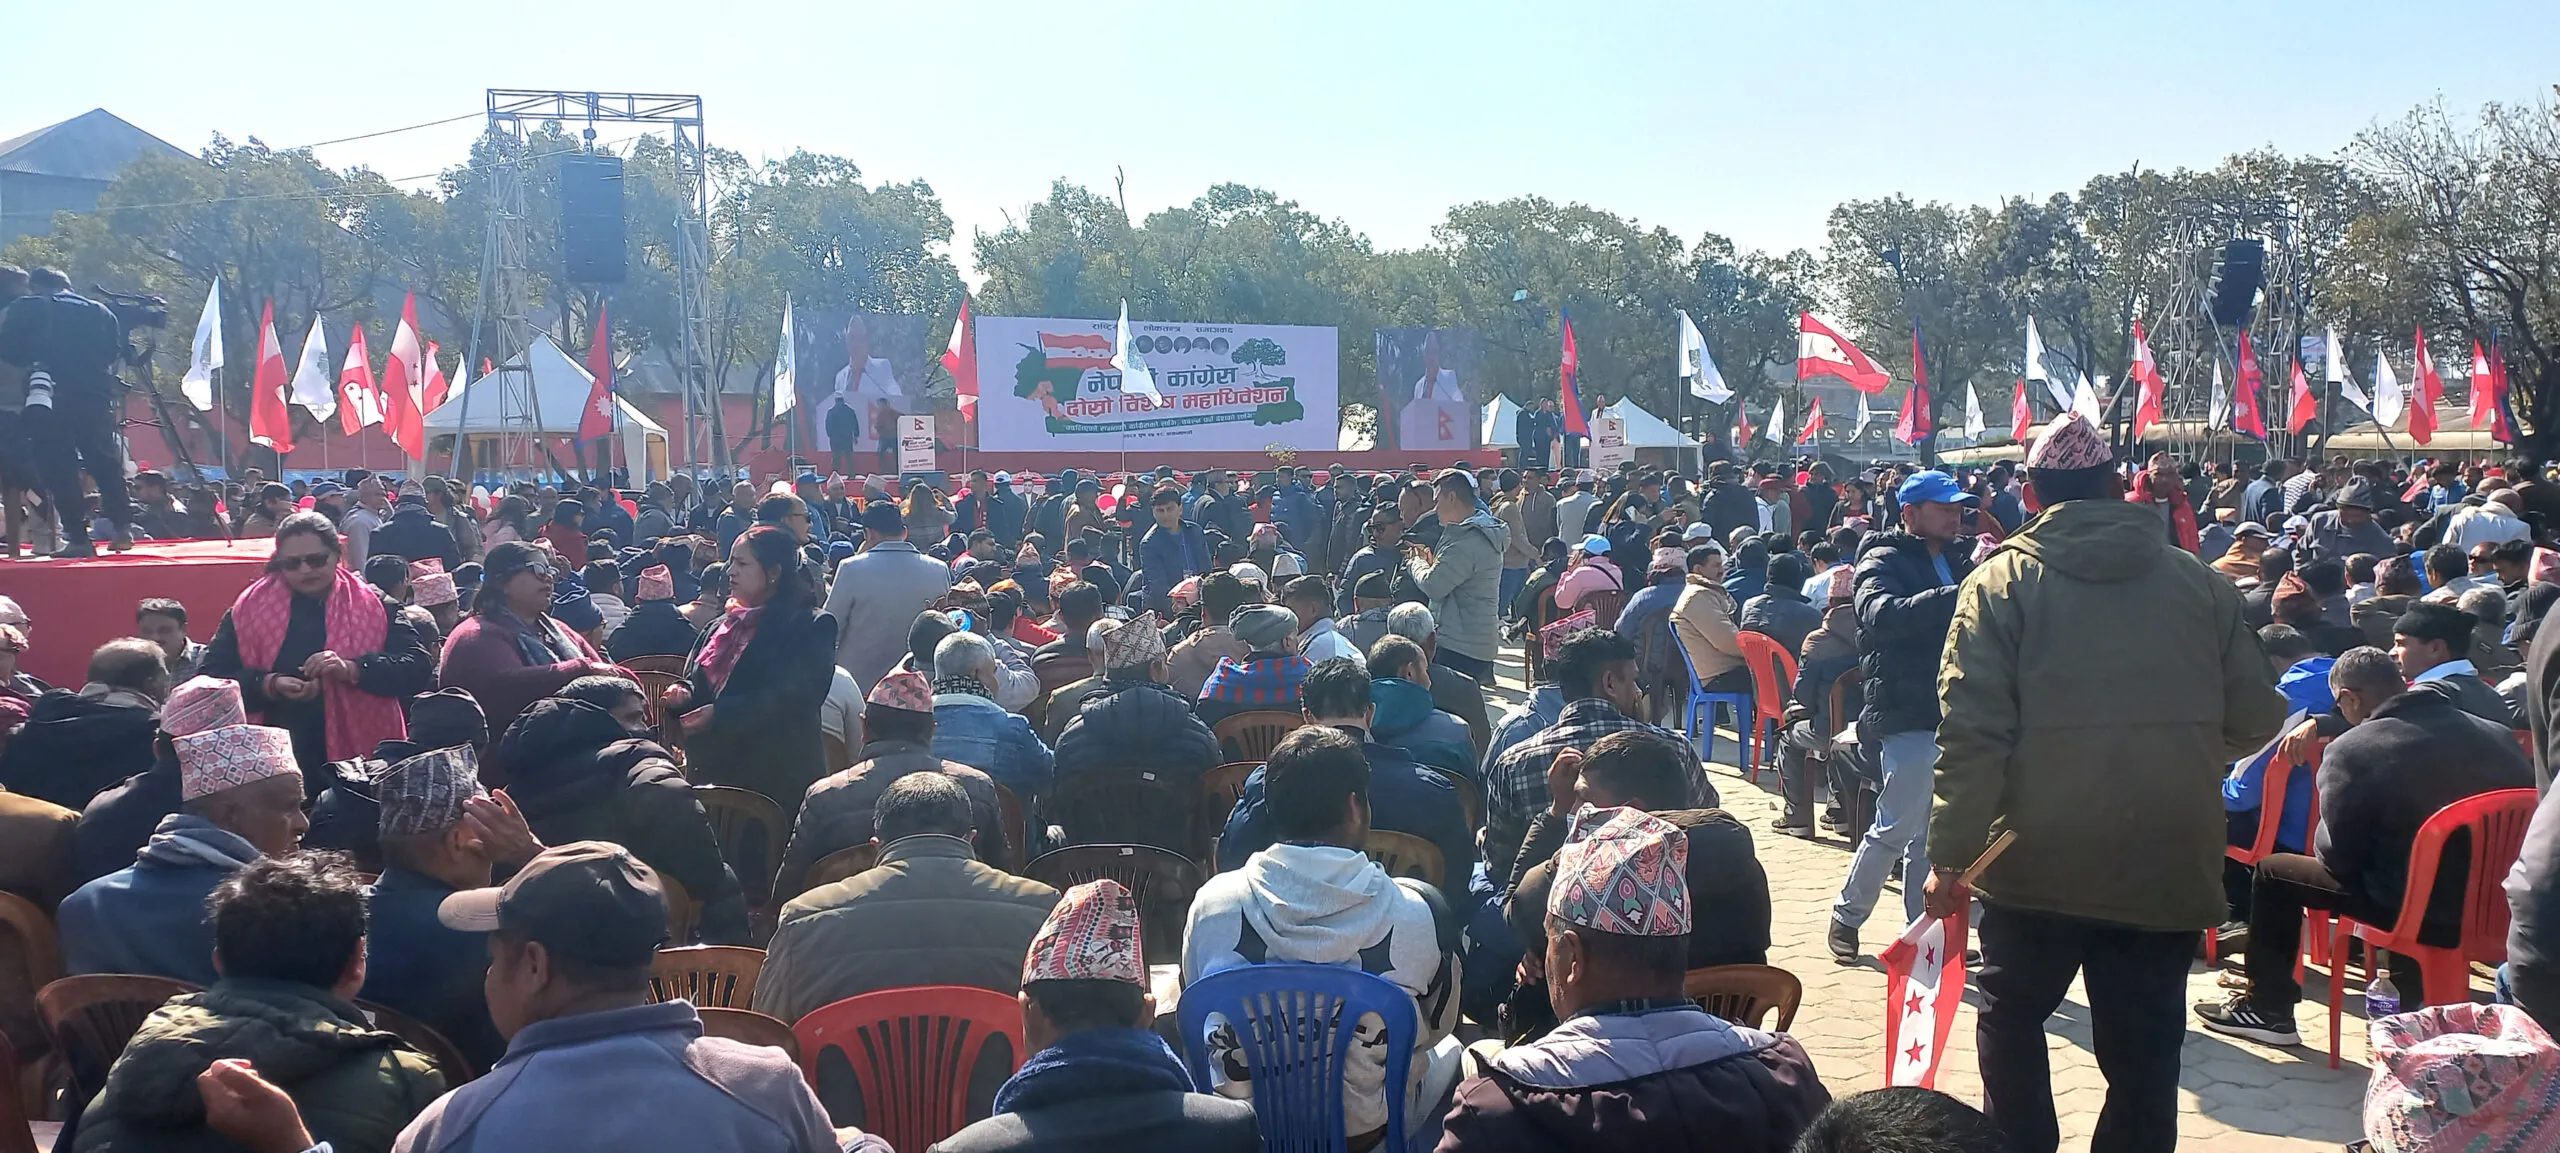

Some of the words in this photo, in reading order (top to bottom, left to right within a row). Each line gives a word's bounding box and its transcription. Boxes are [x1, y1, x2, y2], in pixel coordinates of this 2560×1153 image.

[1166, 364, 1239, 387] कांग्रेस
[1066, 397, 1113, 417] दोस्रो
[1182, 387, 1287, 409] महाधिवेशन
